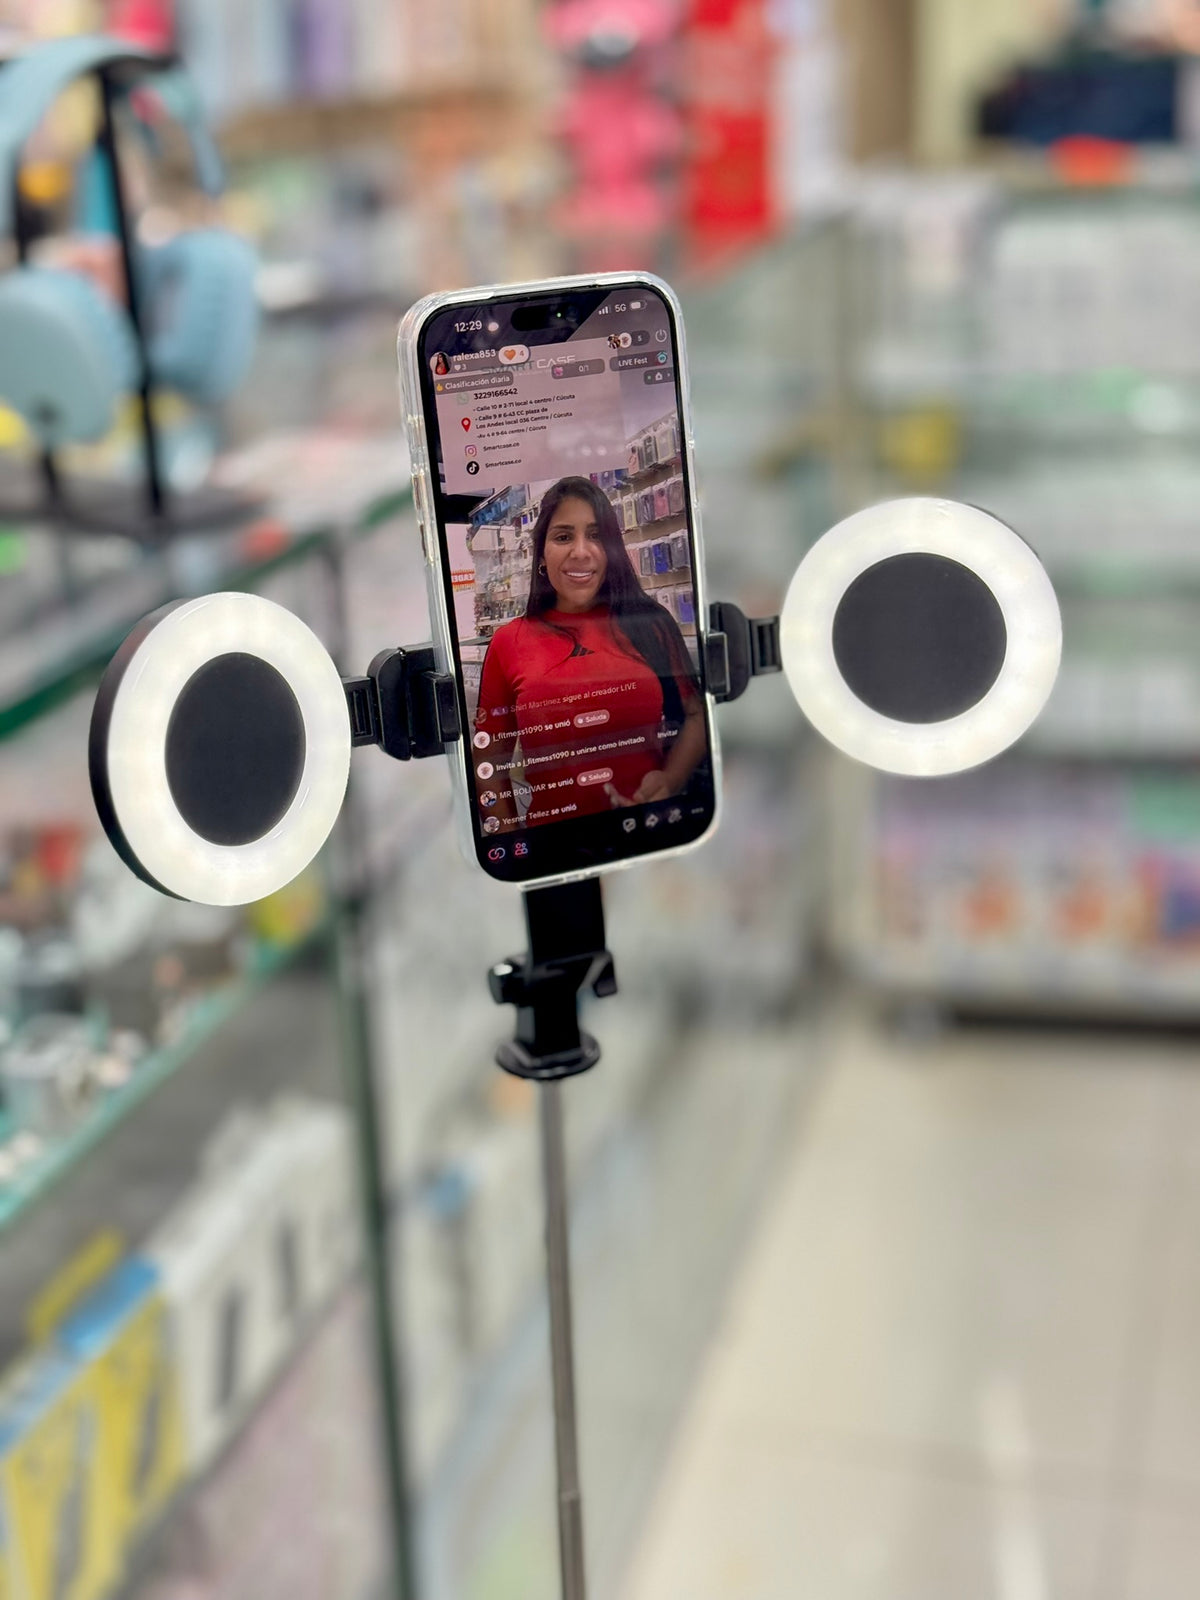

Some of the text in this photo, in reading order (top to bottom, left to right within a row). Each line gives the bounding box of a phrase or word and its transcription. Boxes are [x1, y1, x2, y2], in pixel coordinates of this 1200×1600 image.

[615, 304, 627, 312] 5G
[454, 320, 482, 332] 12:29
[453, 349, 496, 362] ralexa853
[634, 356, 648, 364] Fest
[444, 376, 510, 390] Clasificación diaria
[474, 388, 518, 400] 3229166542
[562, 694, 582, 704] sigue
[584, 690, 590, 698] al
[592, 686, 620, 698] creador
[620, 682, 637, 692] LIVE
[554, 719, 571, 728] unió
[586, 714, 607, 723] Saluda
[657, 729, 678, 738] Invitar
[496, 763, 516, 772] Invita
[576, 746, 598, 756] unirse
[598, 742, 618, 750] como
[618, 736, 646, 747] invitado
[588, 772, 611, 782] Saluda
[500, 790, 512, 800] MR
[514, 784, 546, 797] BOLIVAR
[558, 778, 574, 788] unió
[502, 814, 527, 826] Yesner
[528, 810, 550, 820] Tellez
[560, 804, 578, 814] unió
